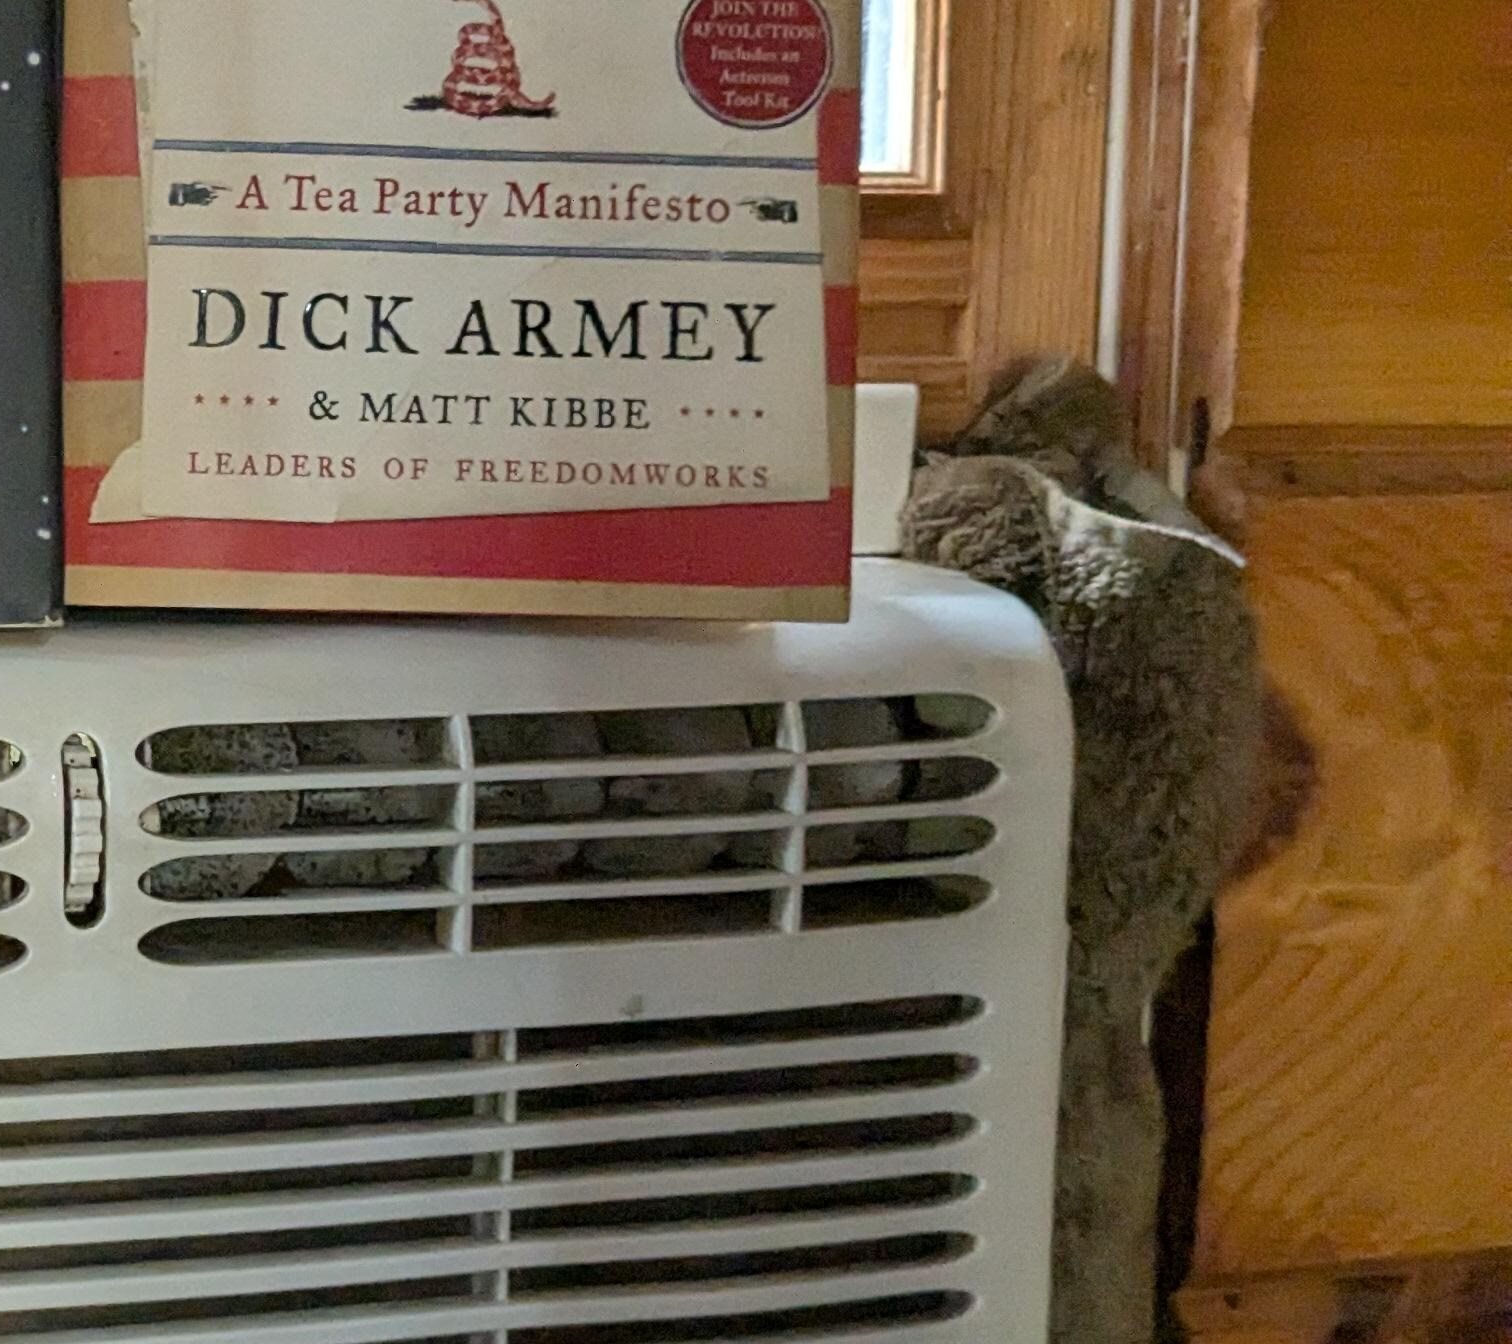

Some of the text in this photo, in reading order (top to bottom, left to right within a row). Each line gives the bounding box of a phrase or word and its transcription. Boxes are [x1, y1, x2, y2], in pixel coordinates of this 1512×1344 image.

[235, 175, 731, 228] A Tea Party Manifesto
[189, 287, 777, 365] DICK ARMEY
[309, 391, 651, 431] & MATT KIBBE
[187, 452, 770, 490] LEADERS OF FREEDOMWORKS
